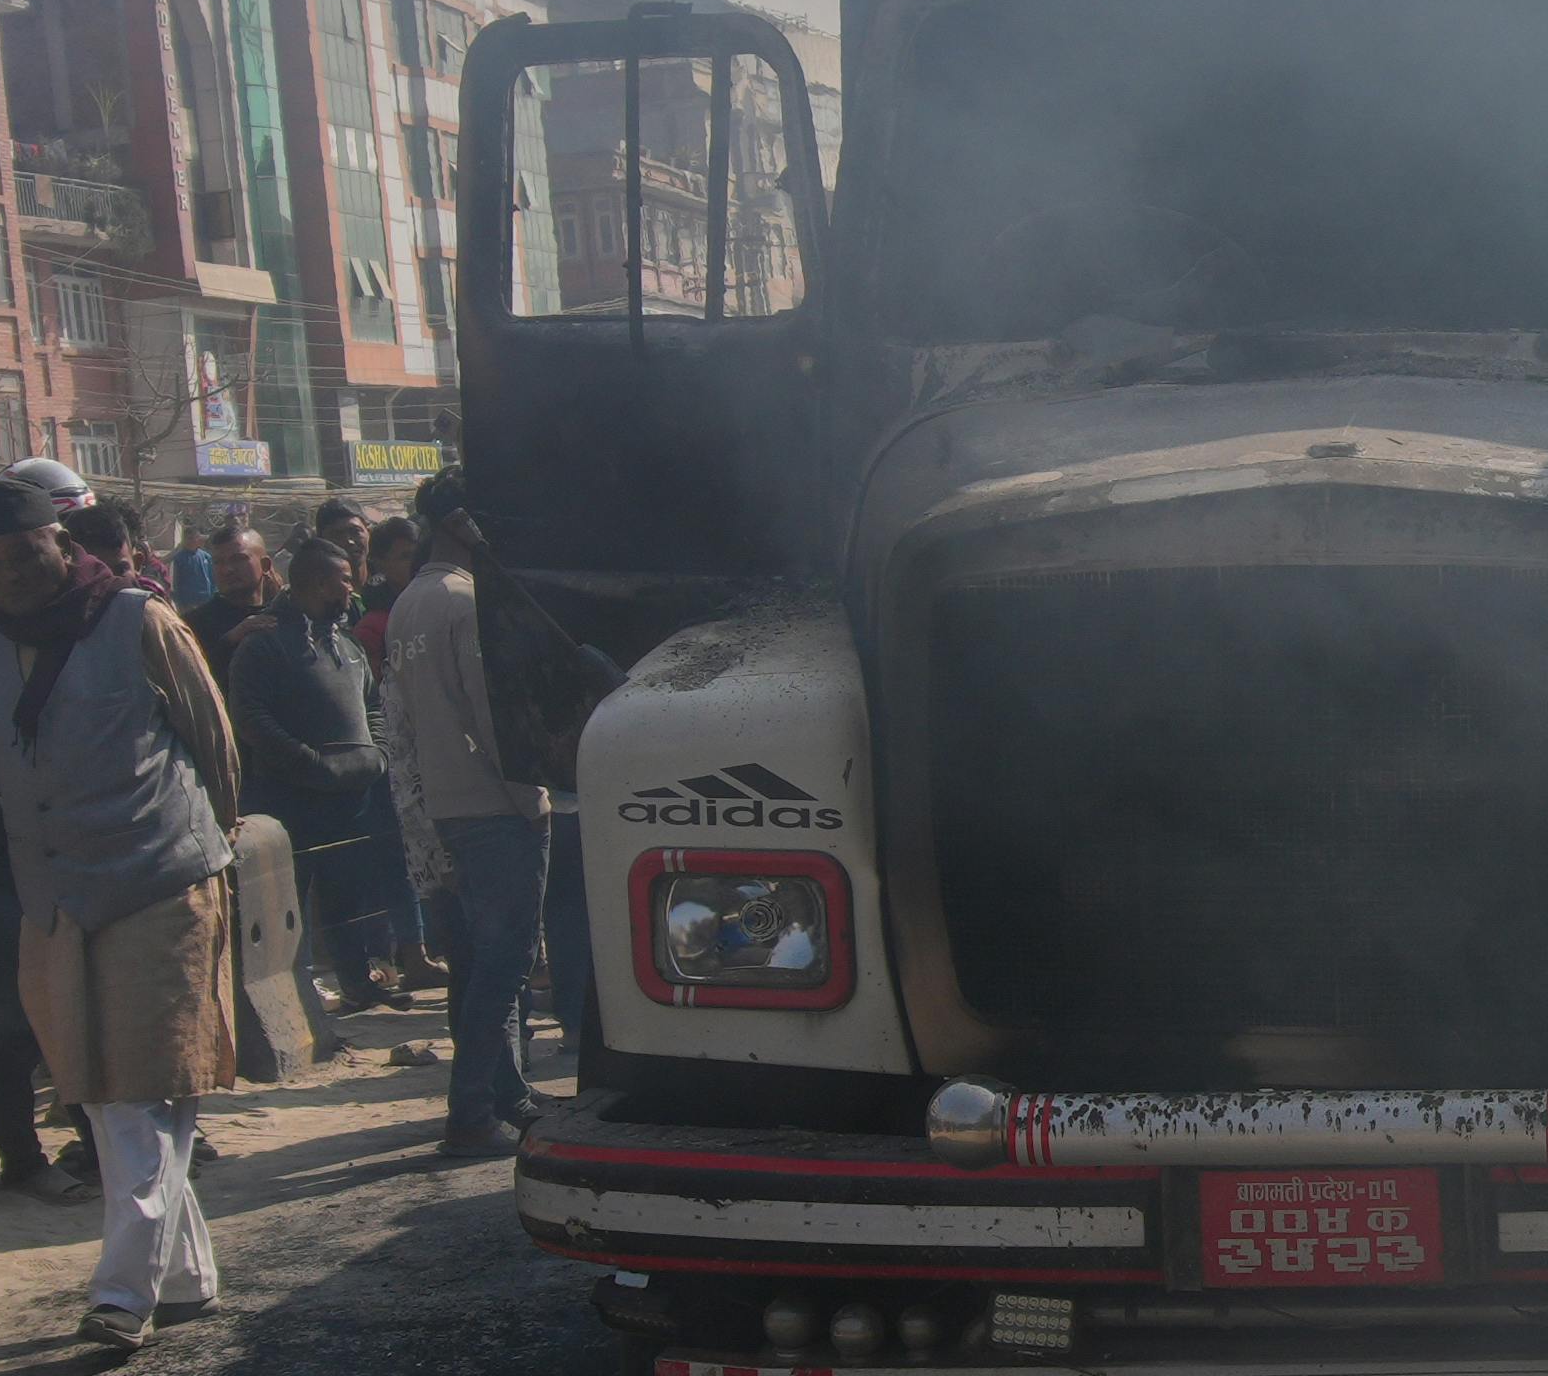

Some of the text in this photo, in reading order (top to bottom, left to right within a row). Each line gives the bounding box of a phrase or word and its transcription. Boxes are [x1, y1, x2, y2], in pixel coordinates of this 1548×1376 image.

[164, 73, 189, 211] CENTER
[356, 444, 439, 470] AGSHA COMPUTER
[618, 799, 844, 830] adidas
[1236, 1175, 1305, 1203] बागमती
[1367, 1206, 1412, 1233] क
[1217, 1235, 1426, 1274] ३४२३
